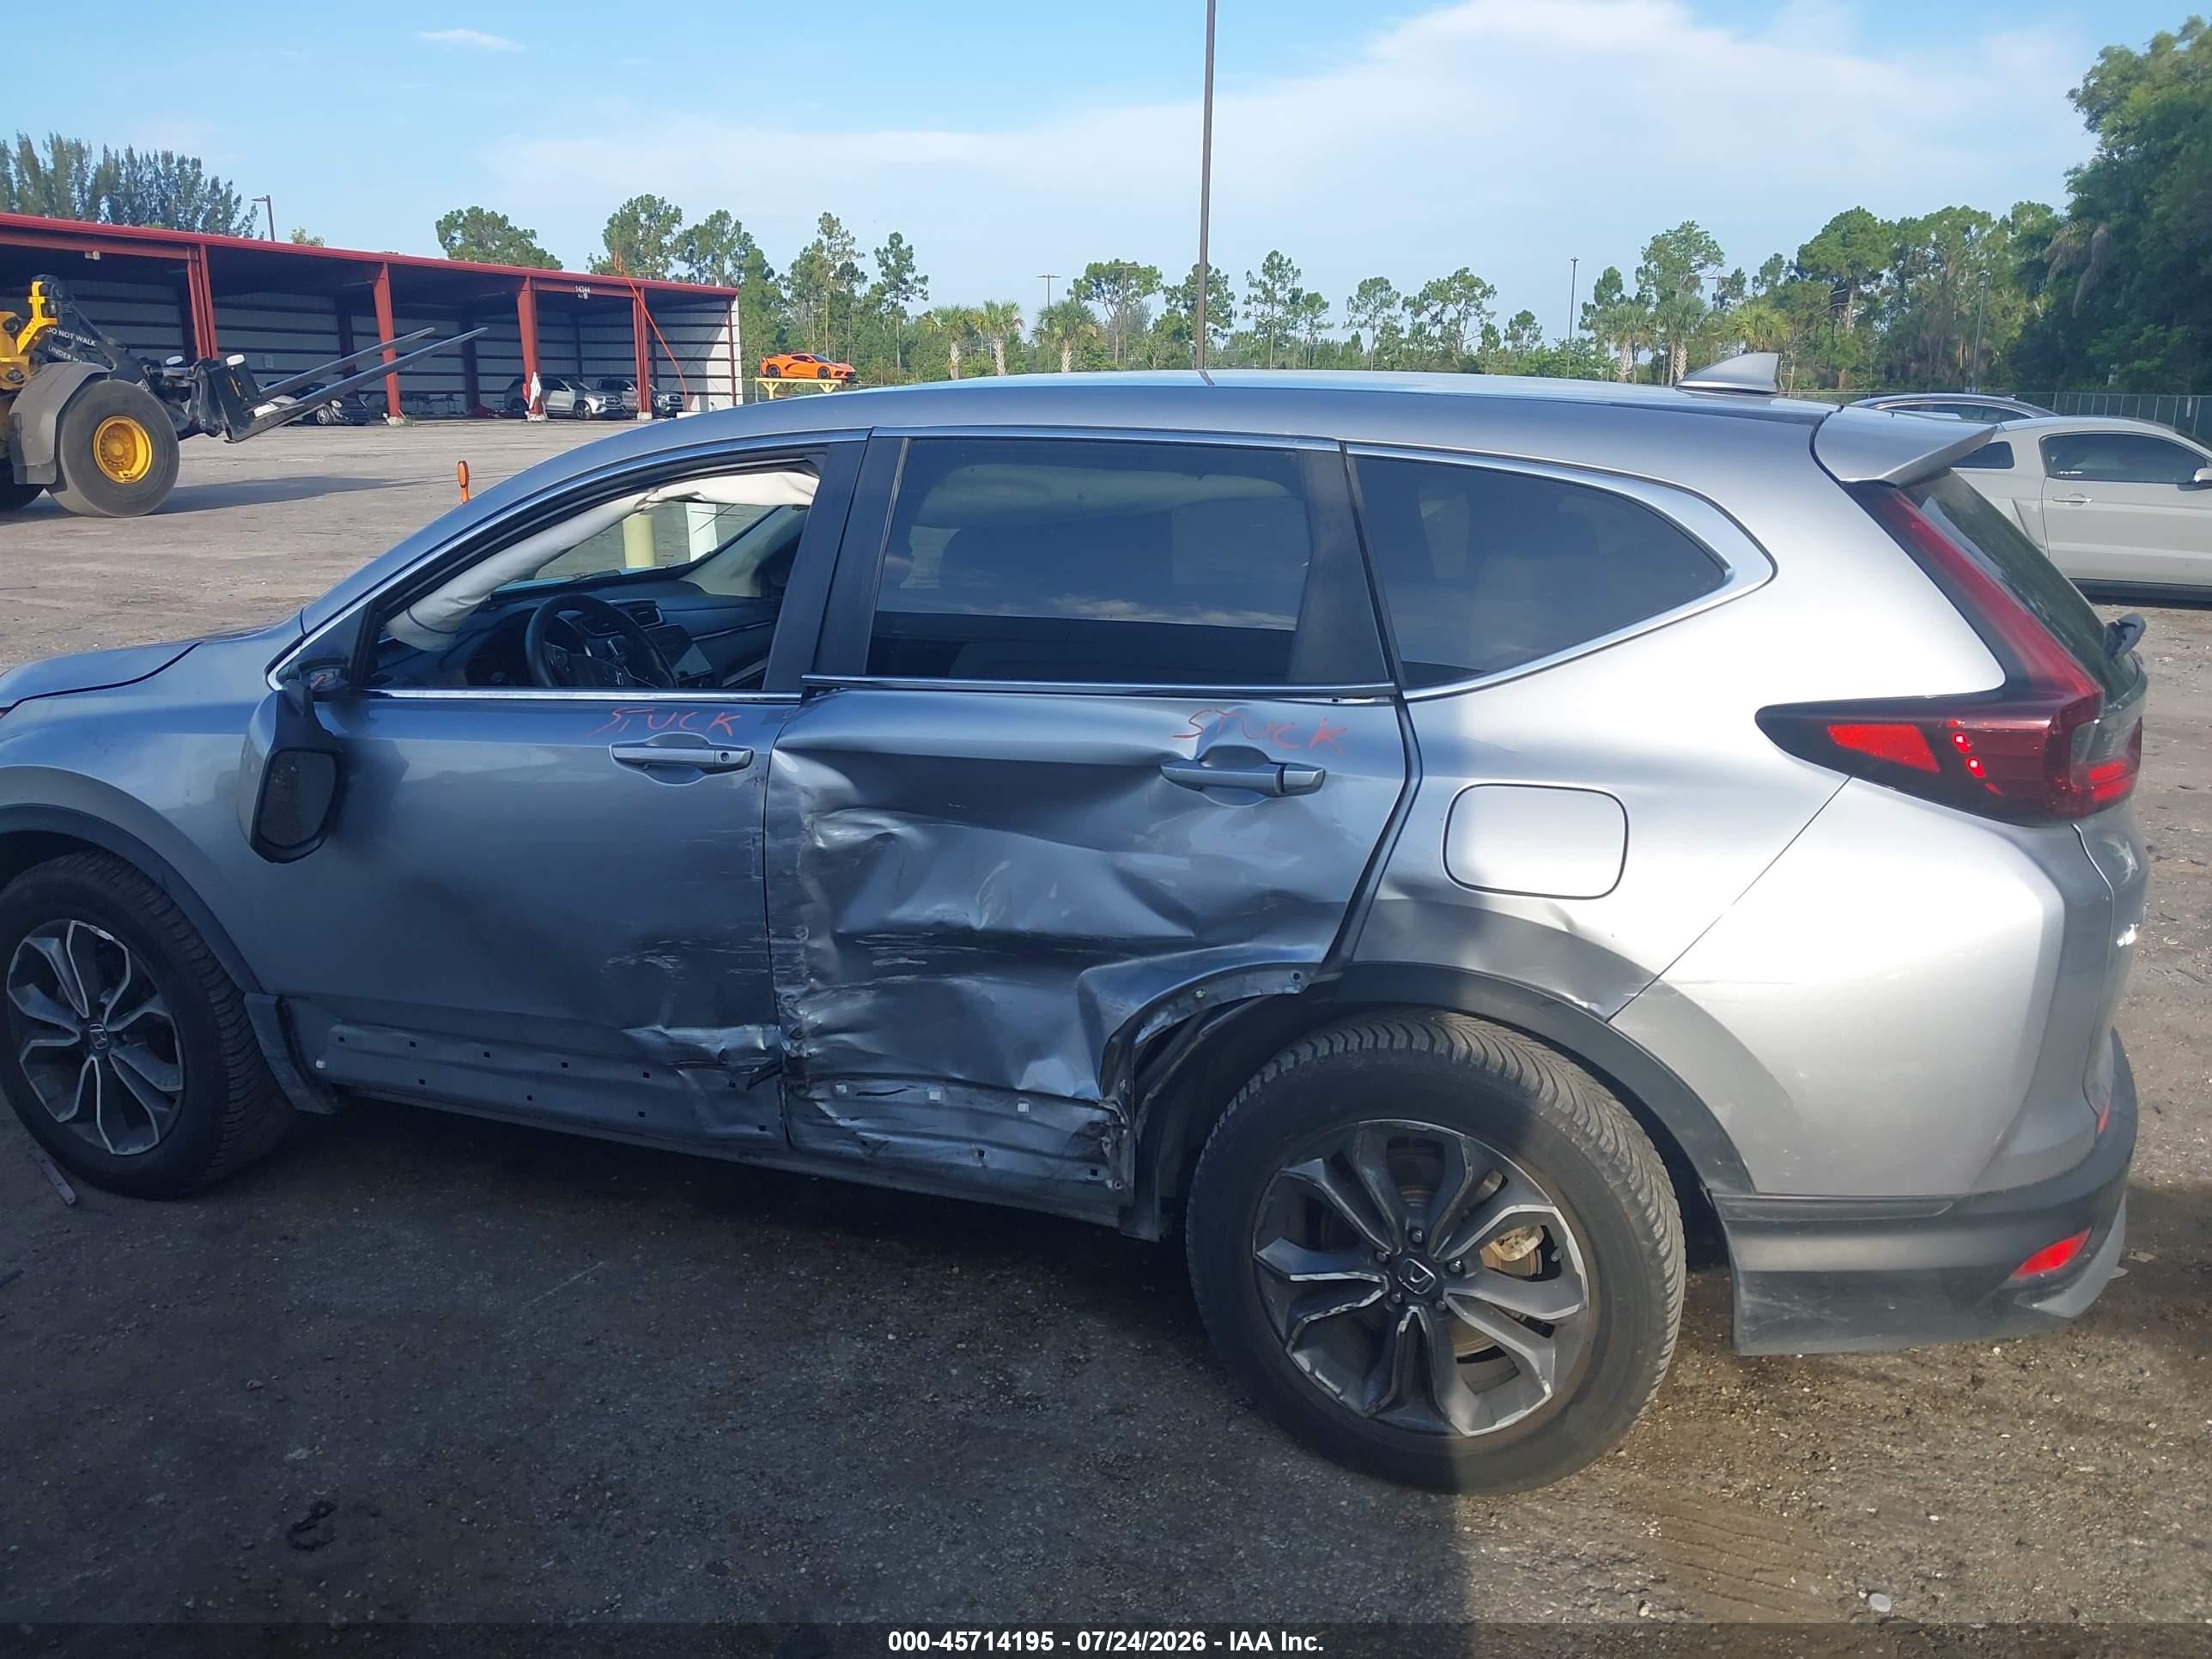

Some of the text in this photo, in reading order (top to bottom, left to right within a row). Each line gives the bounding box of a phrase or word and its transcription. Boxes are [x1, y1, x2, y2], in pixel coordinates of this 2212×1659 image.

[58, 330, 75, 339] NOT
[76, 335, 96, 347] WALK
[48, 344, 71, 361] UNDER
[586, 707, 741, 738] STUCK
[1171, 708, 1348, 756] STUCK
